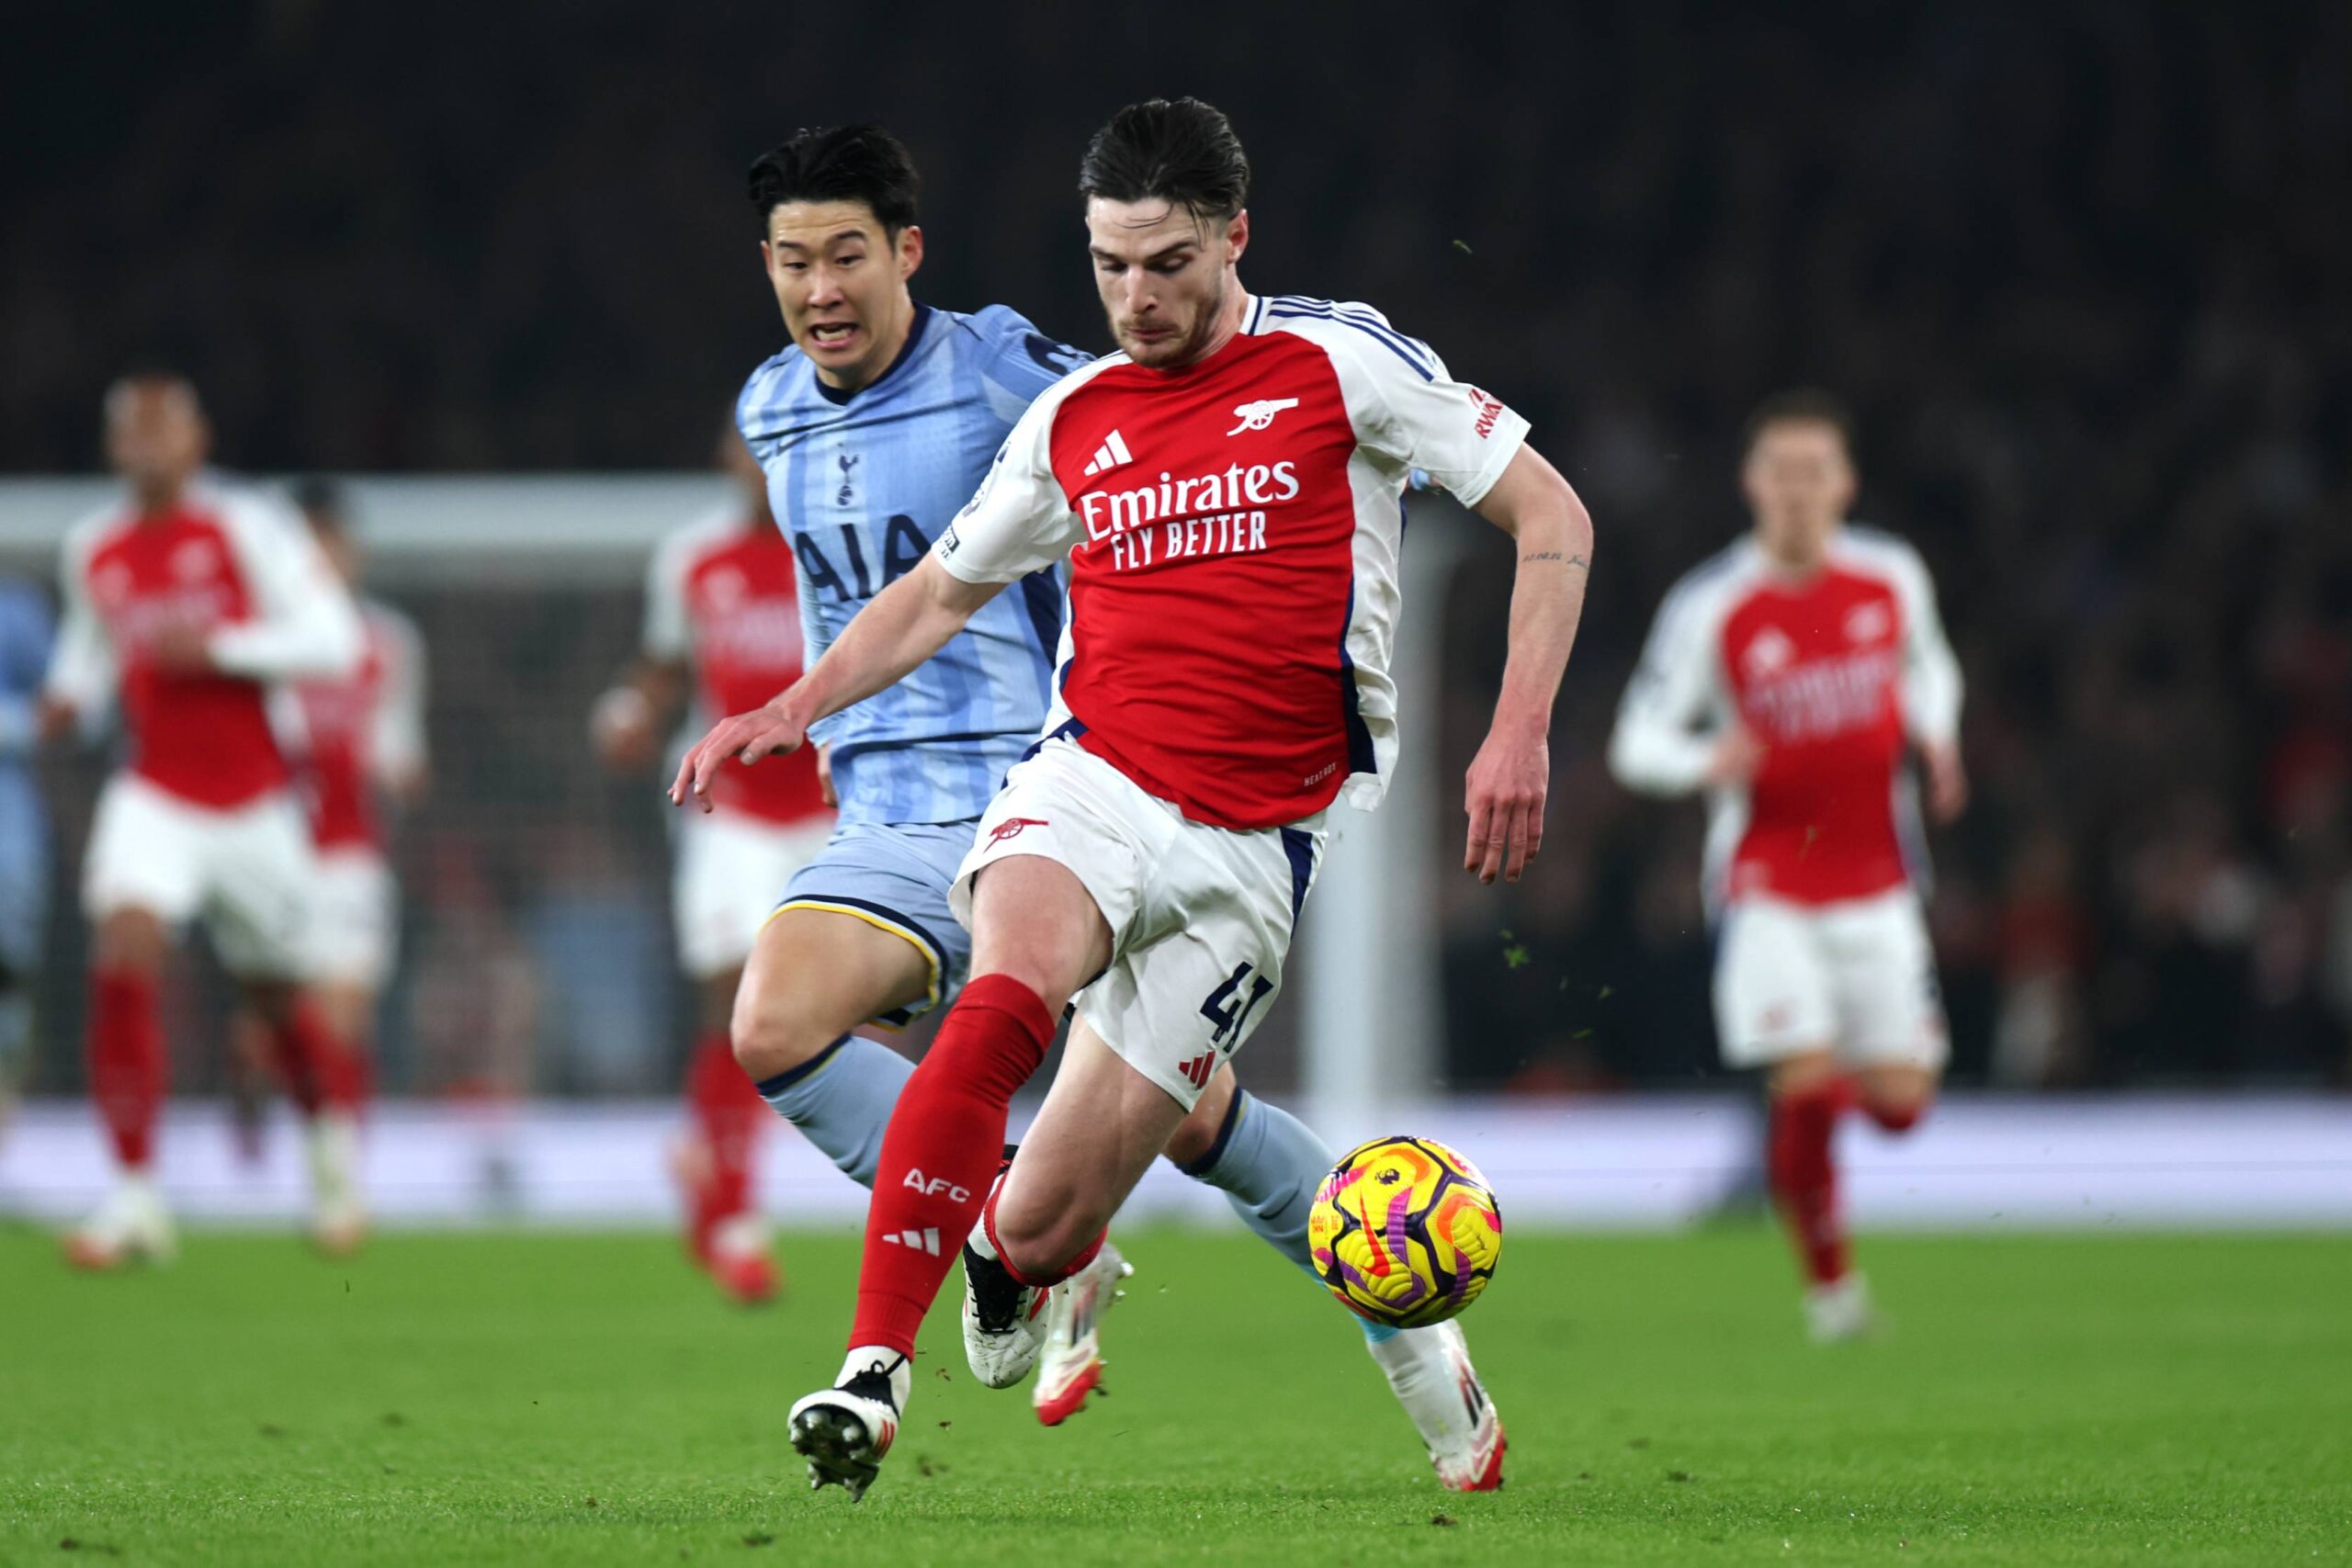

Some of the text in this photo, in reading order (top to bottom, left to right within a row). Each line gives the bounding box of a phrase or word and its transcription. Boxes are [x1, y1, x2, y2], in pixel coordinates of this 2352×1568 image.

[1474, 402, 1504, 439] RWA
[1080, 461, 1299, 542] Emirates
[795, 514, 932, 603] AIA
[1110, 511, 1267, 570] FLY BETTER
[1200, 961, 1273, 1054] 41
[903, 1168, 970, 1203] AFC
